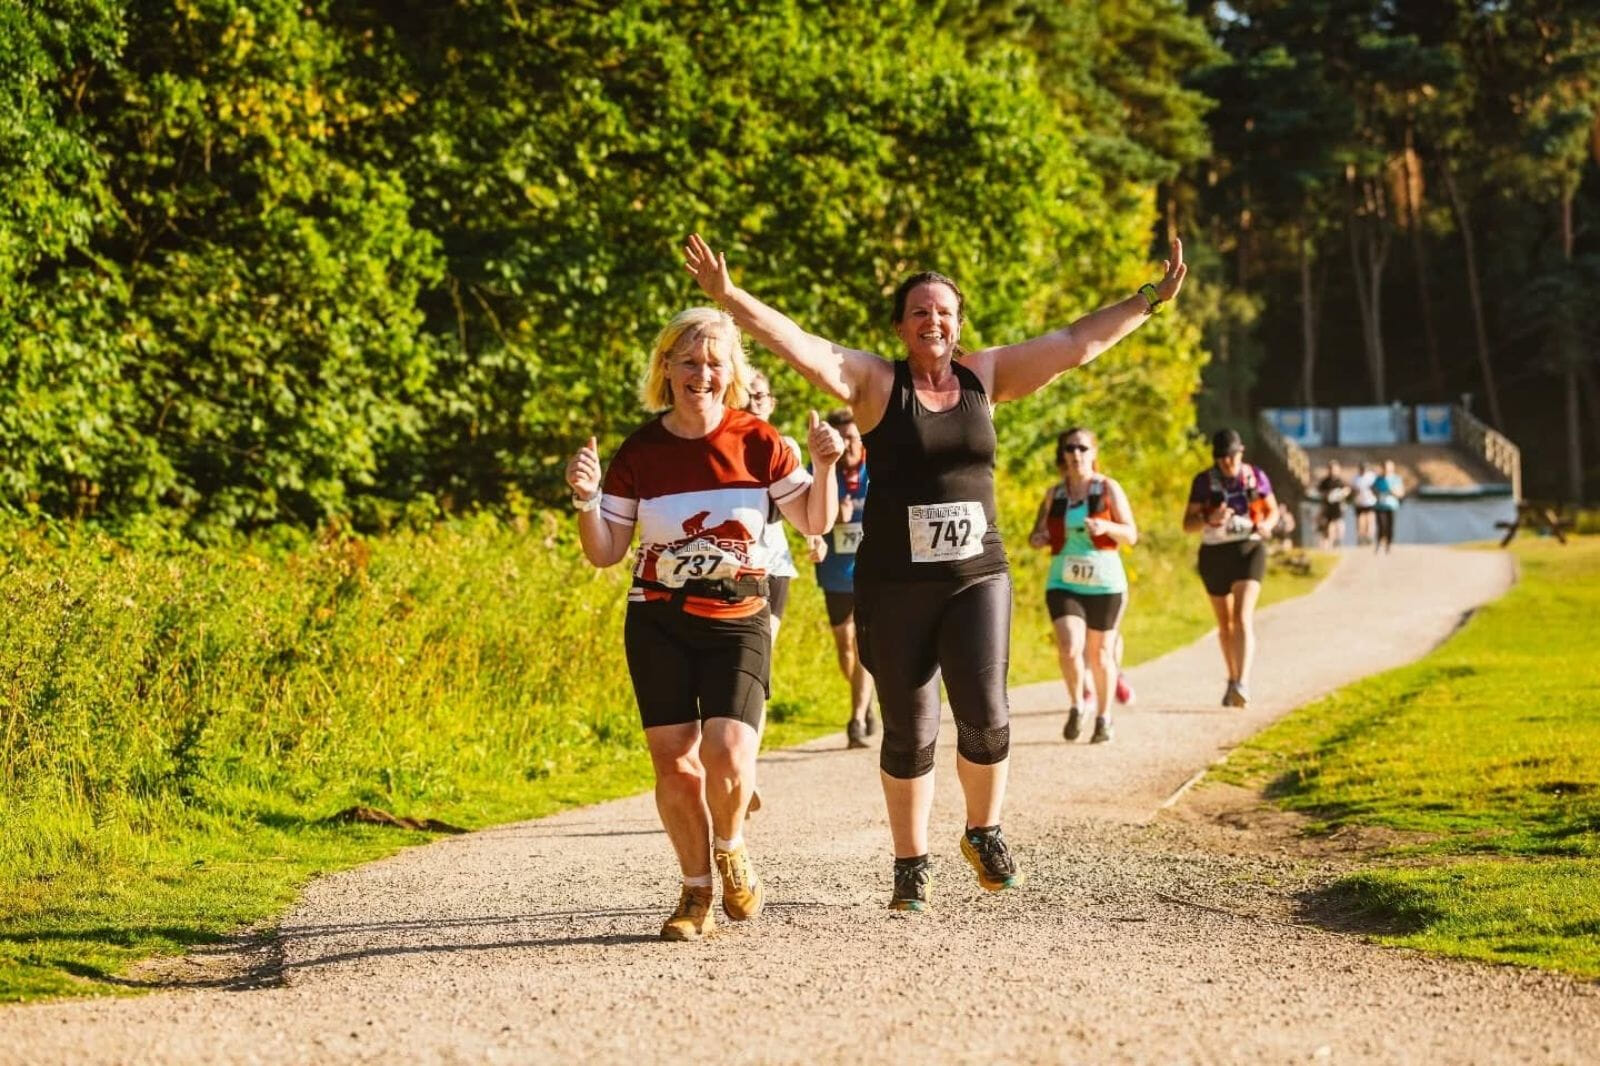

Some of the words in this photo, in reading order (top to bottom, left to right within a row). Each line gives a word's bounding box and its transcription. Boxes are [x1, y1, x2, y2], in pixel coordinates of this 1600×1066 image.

[928, 519, 972, 549] 742
[673, 553, 724, 576] 737
[1072, 564, 1095, 579] 917
